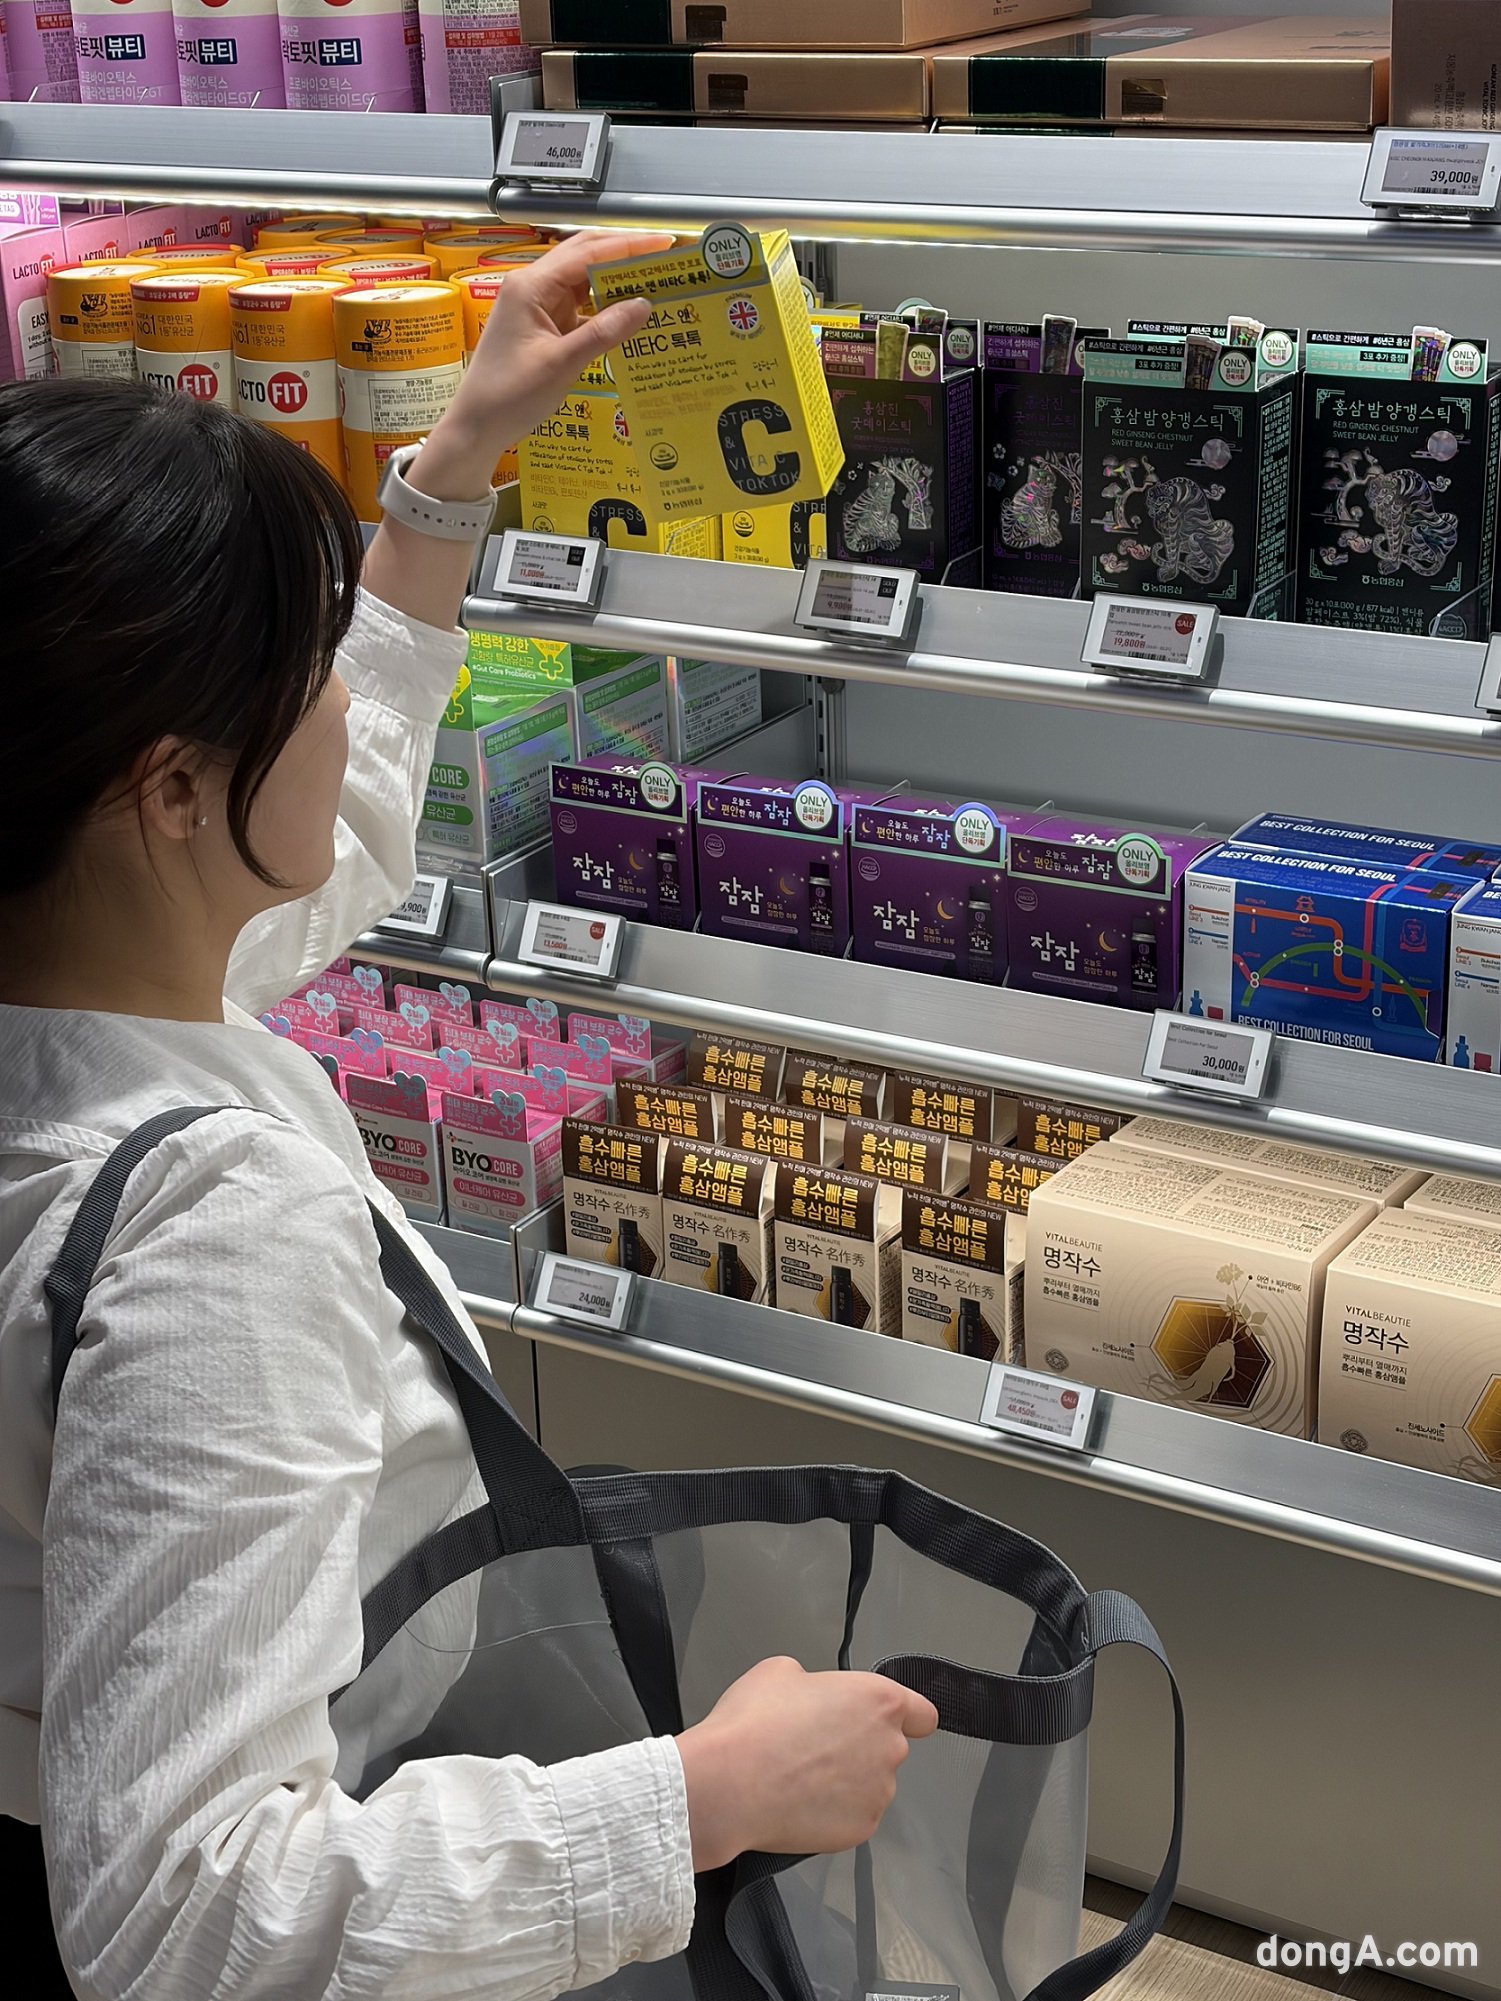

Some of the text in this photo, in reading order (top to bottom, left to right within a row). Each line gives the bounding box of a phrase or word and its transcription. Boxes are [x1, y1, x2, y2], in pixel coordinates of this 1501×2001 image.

[321, 40, 358, 63] 뷰티
[1430, 170, 1479, 184] 39,000원
[195, 220, 232, 239] LACTO FIT
[708, 236, 742, 254] ONLY
[13, 259, 55, 280] LACTO FIT
[606, 283, 645, 299] 스트레스
[158, 314, 193, 325] 대한민국
[250, 324, 285, 335] 대한민국
[621, 329, 702, 359] 비타C 톡톡
[950, 334, 970, 343] ONLY
[1265, 339, 1289, 349] ONLY
[911, 350, 932, 359] ONLY
[1223, 357, 1248, 367] ONLY
[1452, 350, 1477, 360] ONLY
[719, 404, 784, 427] STRESS
[1110, 407, 1224, 432] 홍삼 밤 양갱스틱
[1332, 399, 1451, 424] 홍삼 밤 양갱스틱
[1111, 429, 1193, 442] RED GINSENG CHESTNUT
[1333, 421, 1419, 434] RED GINSENG CHESTNUT
[1333, 430, 1399, 443] SWEET BEAN JELLY
[724, 436, 736, 449] &
[1111, 439, 1174, 450] SWEET BEAN JELLY
[736, 470, 801, 491] TOKTOK
[591, 505, 643, 522] STRESS
[792, 523, 801, 533] &
[1177, 620, 1194, 628] SALE
[470, 631, 529, 653] 생명력 강한
[432, 766, 463, 786] CORE
[644, 776, 671, 788] ONLY
[612, 780, 638, 805] 잠잠
[731, 797, 752, 807] 오늘도
[800, 794, 828, 807] ONLY
[426, 804, 456, 819] 유산균
[721, 804, 746, 818] 편안한
[764, 800, 792, 826] 잠잠
[960, 817, 989, 830] ONLY
[876, 826, 902, 841] 편안한
[922, 823, 951, 850] 잠잠
[888, 819, 909, 830] 오늘도
[1259, 819, 1436, 851] BEST COLLECTION FOR SEOUL
[1122, 847, 1154, 861] ONLY
[1217, 849, 1398, 883] BEST COLLECTION FOR SEOUL
[572, 852, 615, 890] 잠잠
[1082, 854, 1113, 880] 잠잠
[719, 876, 764, 915] 잠잠
[872, 900, 920, 940] 잠잠
[1030, 931, 1080, 971] 잠잠
[1237, 1014, 1375, 1051] BEST COLLECTION FOR SEOUL
[704, 1045, 766, 1073] 흡수빠른
[1202, 1055, 1245, 1073] 30,000원
[702, 1065, 763, 1093] 홍삼앰플
[801, 1069, 864, 1099] 흡수빠른
[634, 1093, 698, 1120] 흡수빠른
[800, 1089, 863, 1116] 홍삼앰플
[911, 1087, 976, 1117] 흡수빠른
[635, 1110, 699, 1138] 홍삼앰플
[741, 1110, 805, 1140] 흡수빠른
[910, 1108, 975, 1137] 홍삼앰플
[1034, 1114, 1101, 1143] 흡수빠른
[399, 1140, 422, 1155] CORE
[578, 1134, 642, 1163] 흡수빠른
[741, 1130, 804, 1160] 홍삼앰플
[860, 1132, 927, 1164] 흡수빠른
[452, 1147, 518, 1176] BYO CORE
[577, 1155, 642, 1183] 홍삼앰플
[681, 1154, 748, 1185] 흡수빠른
[860, 1154, 925, 1184] 홍삼앰플
[679, 1175, 744, 1207] 홍삼앰플
[791, 1176, 859, 1209] 흡수빠른
[573, 1191, 651, 1220] 명작수 名作秀
[790, 1198, 857, 1229] 홍삼앰플
[672, 1214, 751, 1244] 명작수 名作秀
[919, 1206, 989, 1241] 흡수빠른
[784, 1236, 866, 1268] 명작수 名作秀
[918, 1228, 987, 1262] 홍삼앰플
[1045, 1231, 1103, 1252] VITALBEAUTIE
[1043, 1246, 1102, 1278] 명작수
[911, 1266, 996, 1301] 명작수 名作秀
[1043, 1286, 1071, 1301] 흡수빠른
[1345, 1304, 1411, 1328] VITALBEAUTIE
[1343, 1320, 1410, 1354] 명작수
[1341, 1363, 1373, 1378] 흡수빠른
[1342, 1353, 1408, 1376] 뿌리부터 열매까지
